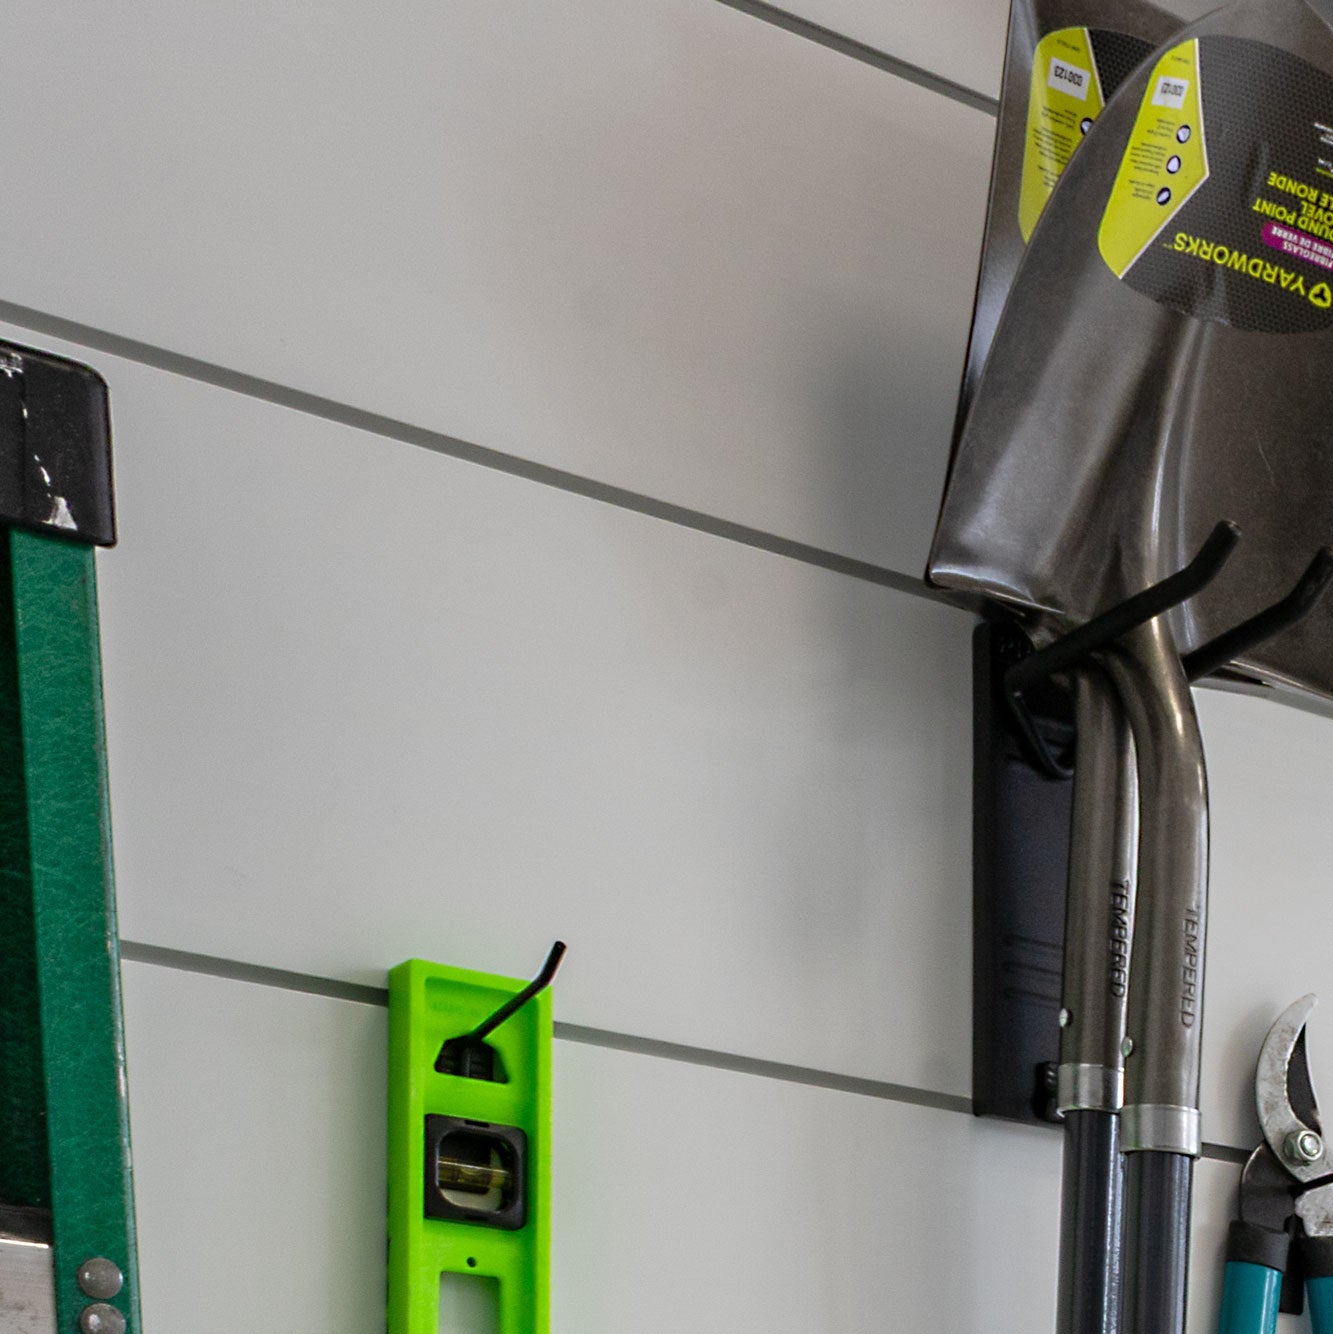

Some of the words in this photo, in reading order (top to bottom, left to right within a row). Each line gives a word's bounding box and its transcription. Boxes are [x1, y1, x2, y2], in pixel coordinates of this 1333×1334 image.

[1267, 171, 1320, 200] RONDE
[1252, 197, 1297, 226] POINT
[1173, 232, 1306, 296] YARDWORKS
[1283, 240, 1333, 268] FIBREGLASS
[1110, 879, 1130, 998] TEMPERED
[1179, 906, 1200, 1029] TEMPERED
